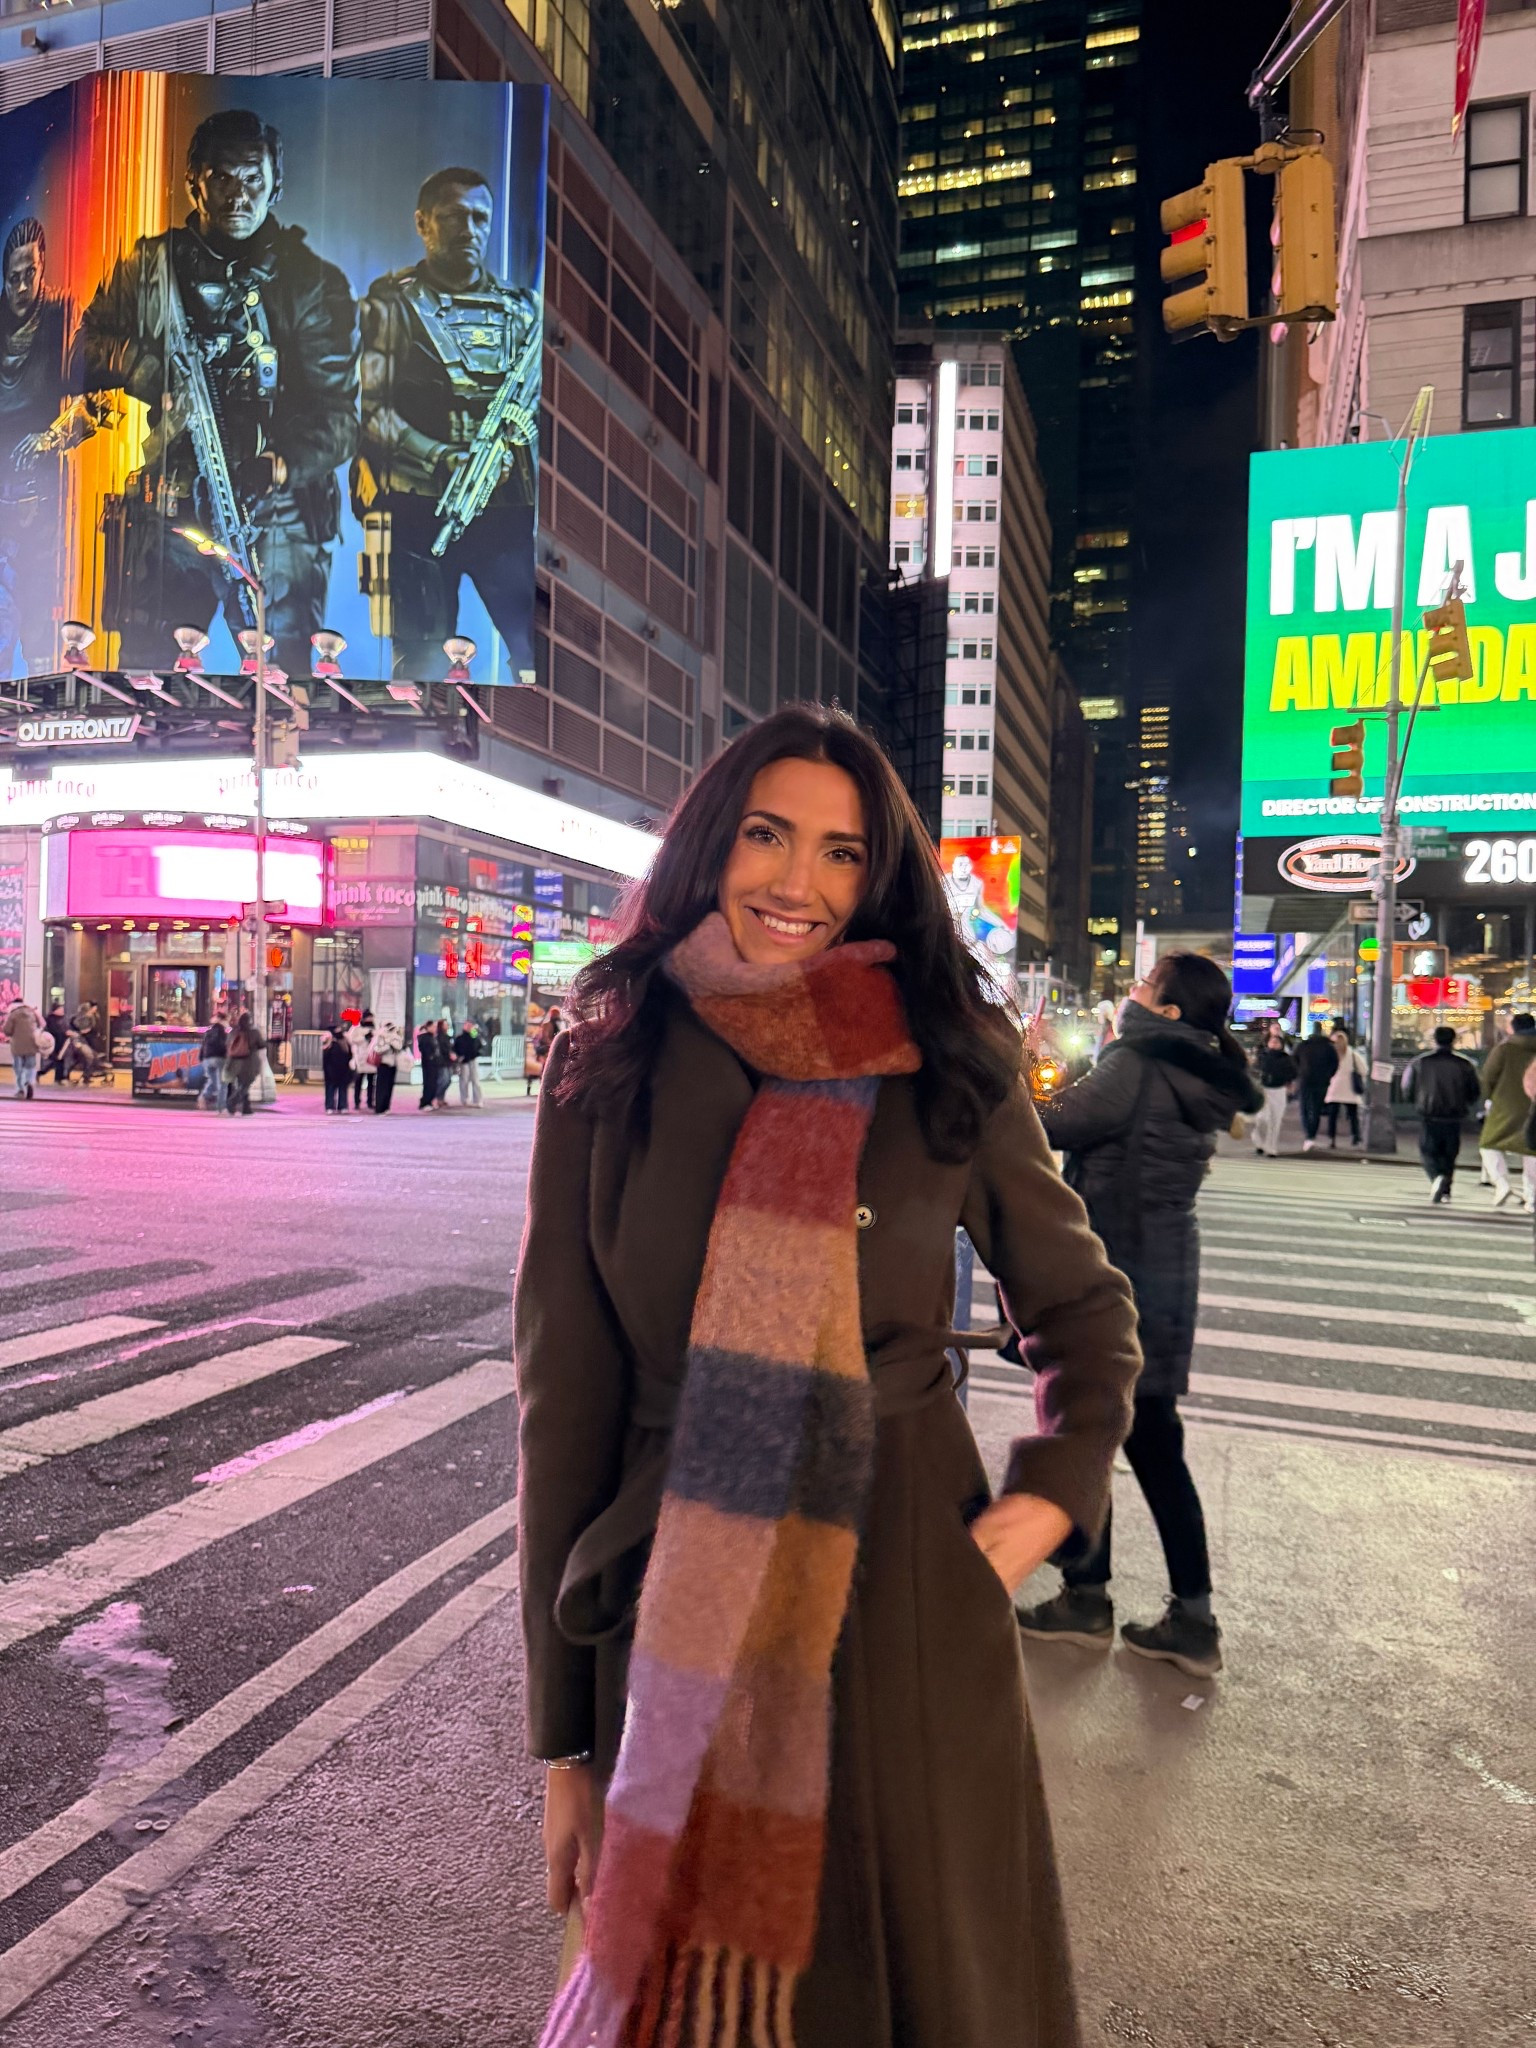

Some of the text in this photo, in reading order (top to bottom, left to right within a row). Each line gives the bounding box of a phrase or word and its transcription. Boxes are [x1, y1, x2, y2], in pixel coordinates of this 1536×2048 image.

[1271, 511, 1400, 615] I'M
[1417, 505, 1477, 608] A
[1261, 797, 1356, 817] DIRECTOR
[1301, 853, 1342, 874] Yard
[1464, 838, 1536, 884] 260
[376, 884, 416, 907] taco
[417, 885, 443, 918] pink
